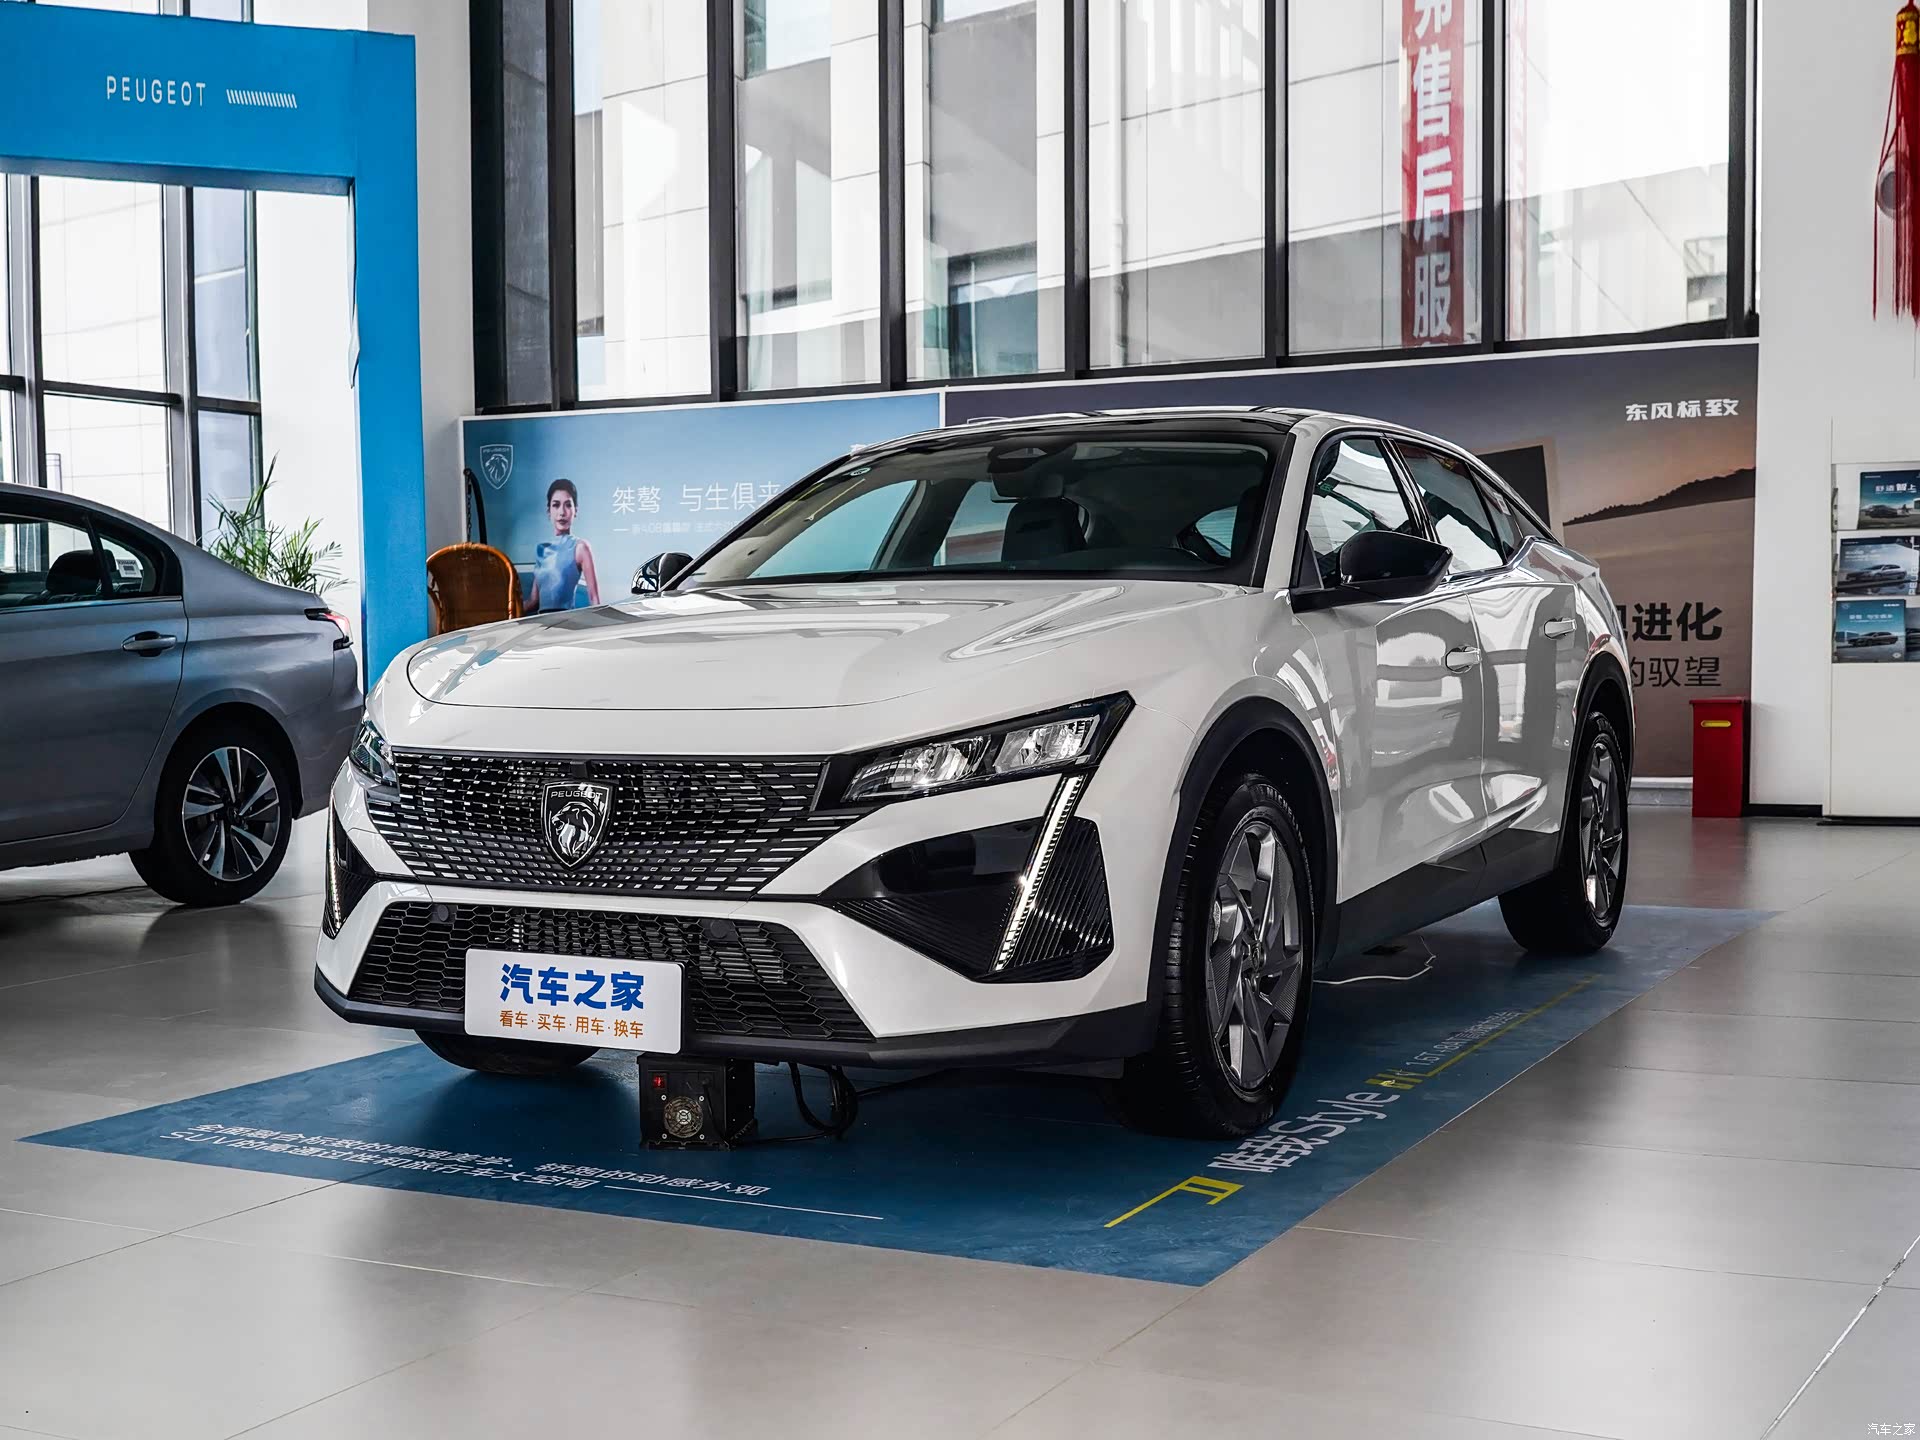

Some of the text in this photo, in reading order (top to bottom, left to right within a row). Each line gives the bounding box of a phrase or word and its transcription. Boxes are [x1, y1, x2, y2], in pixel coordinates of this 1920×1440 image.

[106, 75, 206, 107] PEUGEOT
[1625, 398, 1740, 421] 东风标致
[611, 480, 782, 515] 桀骜 与生俱来
[551, 790, 603, 798] PEUGEOT
[500, 963, 645, 1012] 汽车之家
